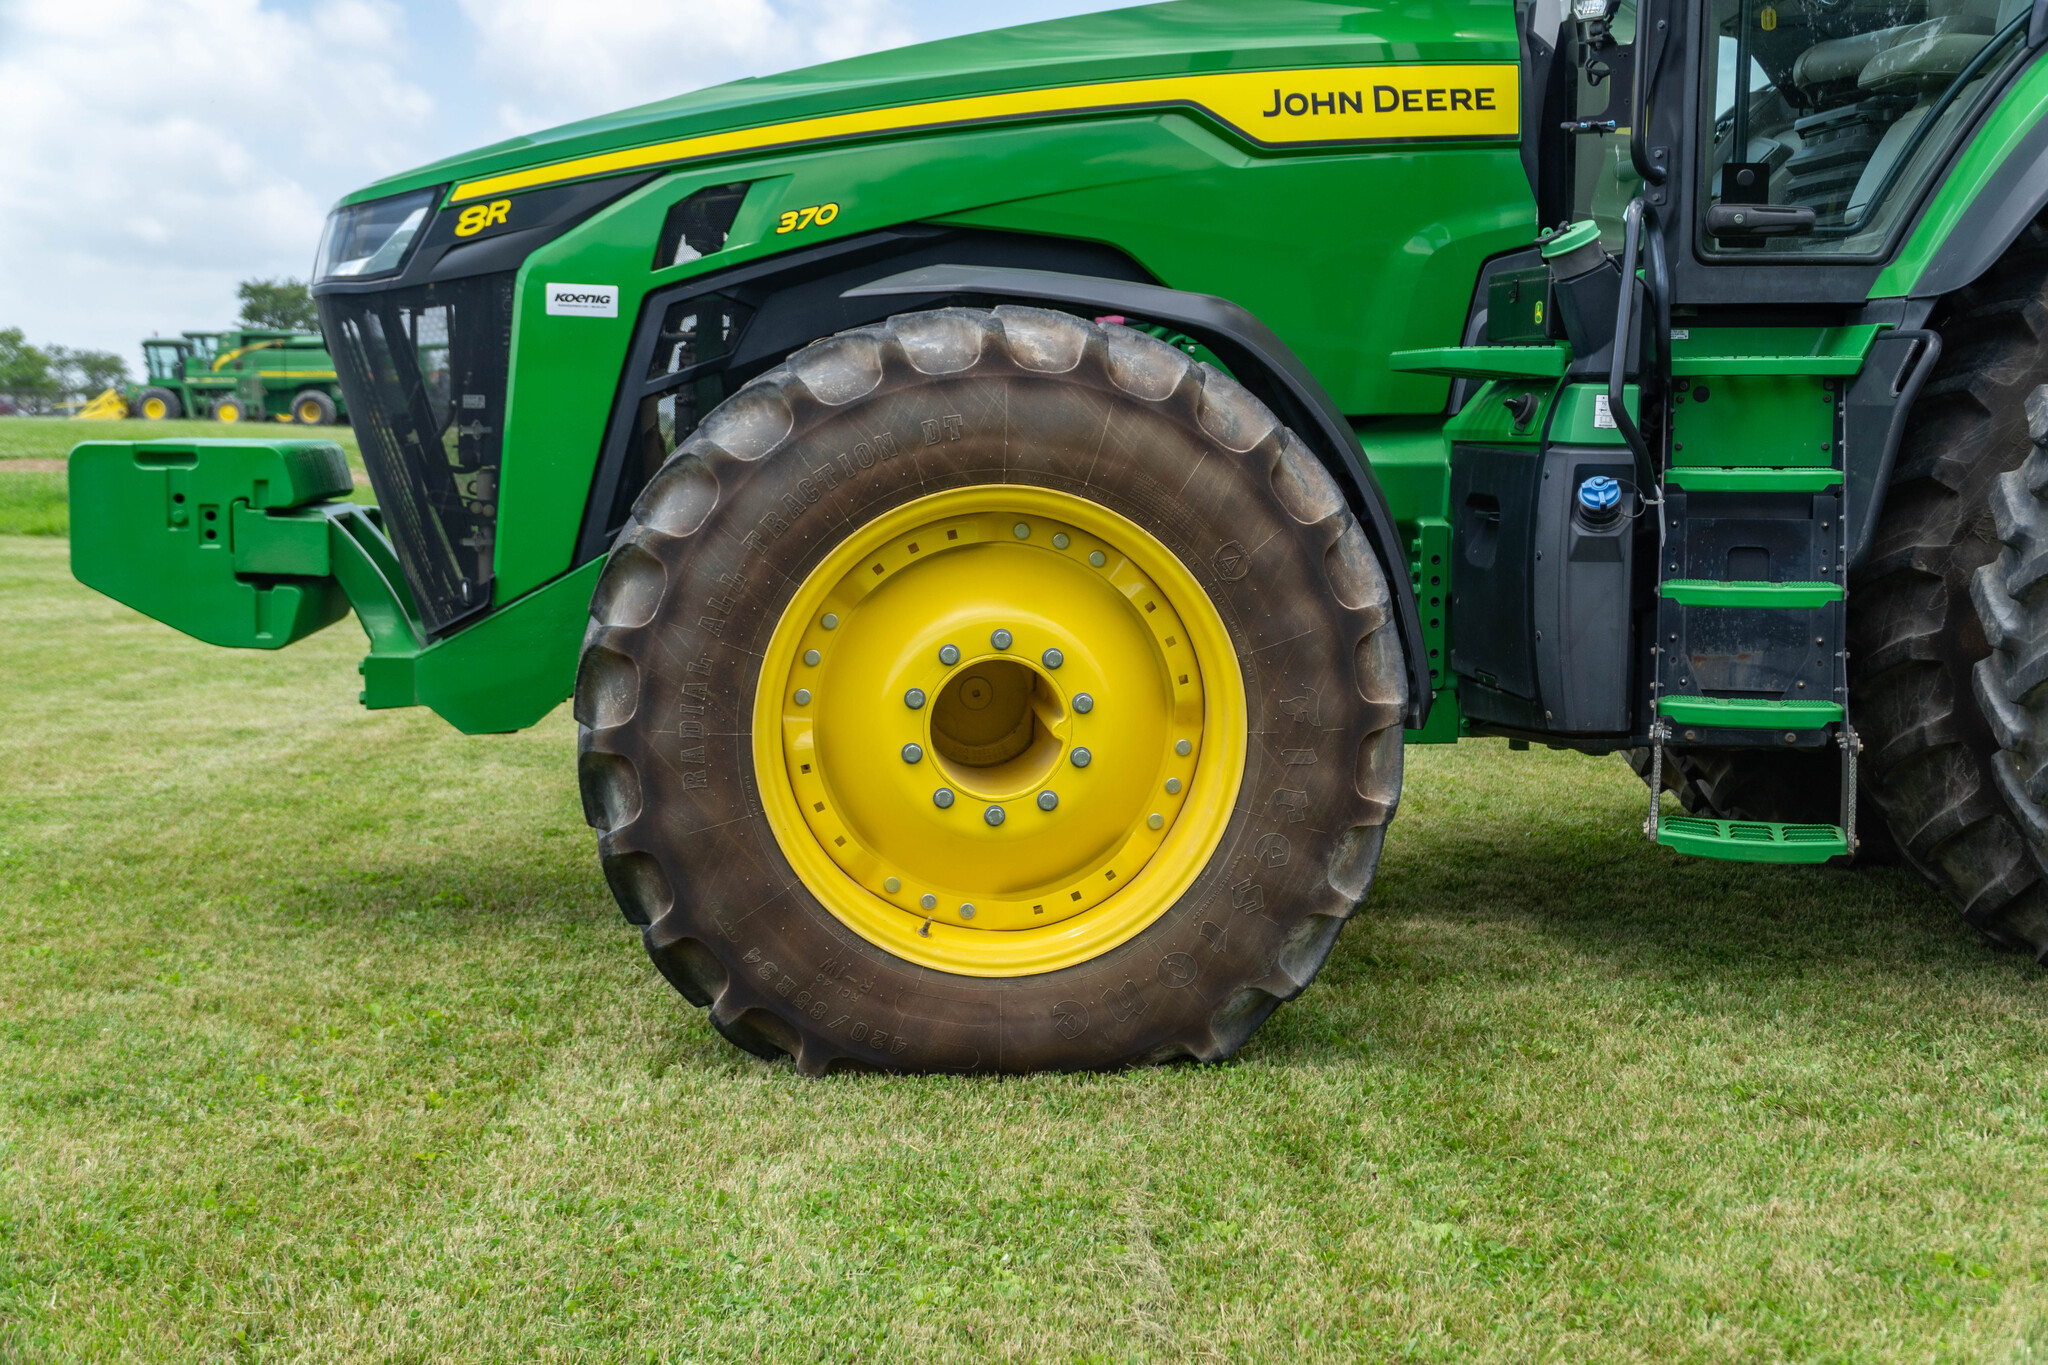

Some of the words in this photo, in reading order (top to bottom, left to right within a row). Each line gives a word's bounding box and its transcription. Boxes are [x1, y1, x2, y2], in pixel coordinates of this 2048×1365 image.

[1263, 88, 1363, 118] JOHN
[1373, 85, 1496, 113] DEERE
[454, 199, 512, 238] 8R
[775, 203, 839, 235] 370
[679, 656, 713, 790] RADIAL
[698, 571, 748, 638] ALL
[741, 431, 899, 556] TRACTION
[921, 414, 964, 446] DT
[1052, 686, 1321, 1040] Firestone
[819, 957, 875, 995] R-1W
[743, 947, 907, 1054] 420/85R34
